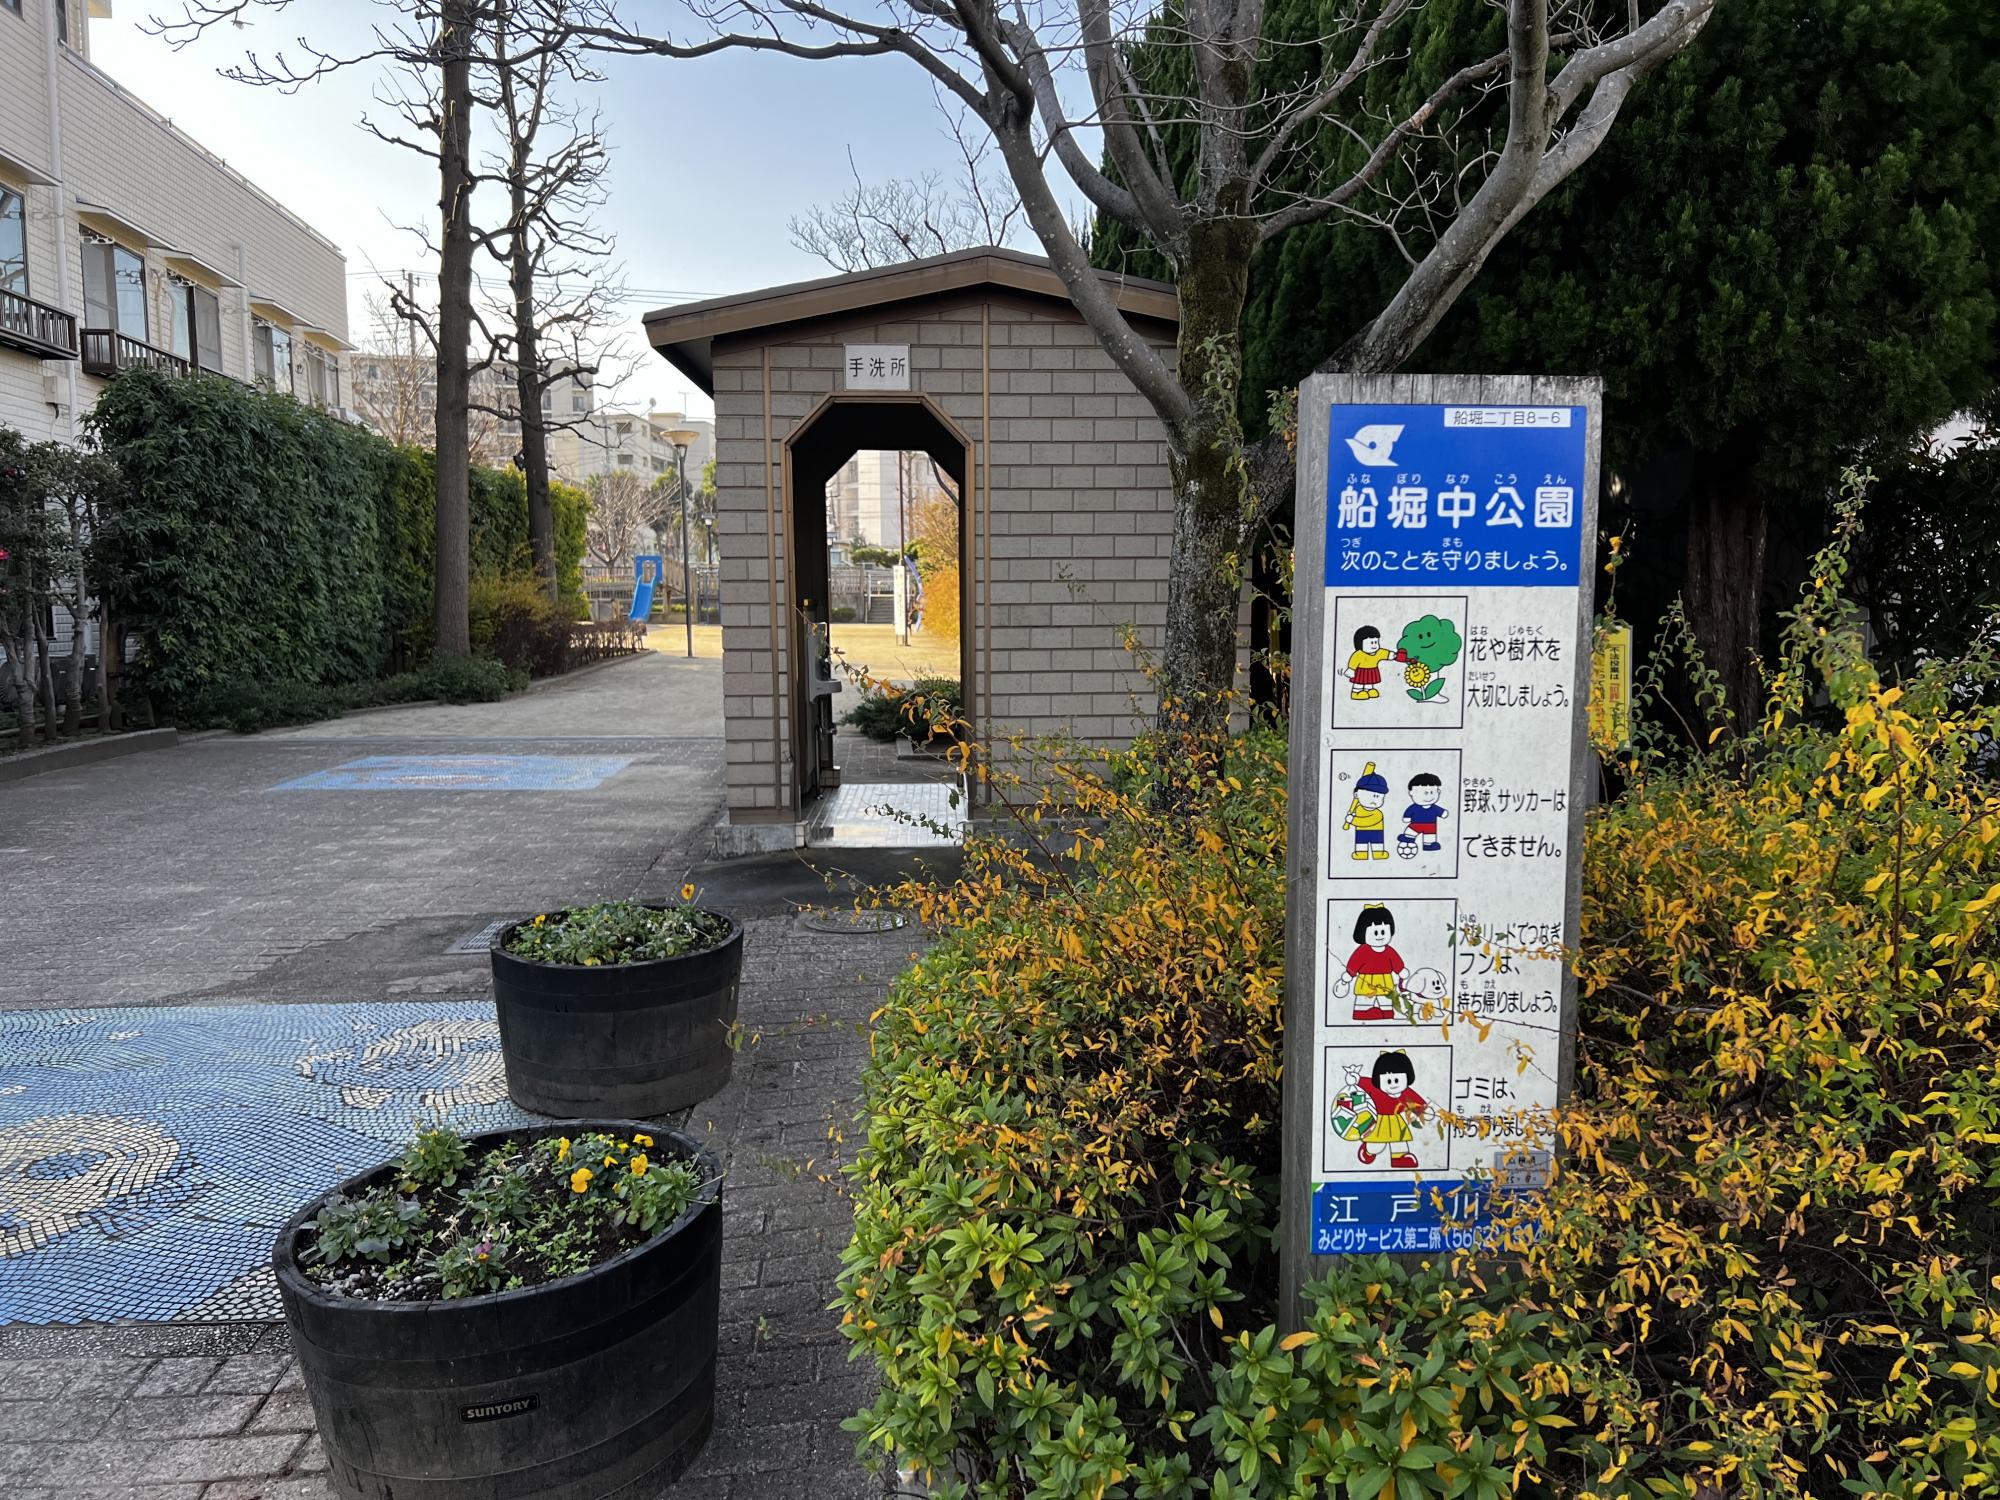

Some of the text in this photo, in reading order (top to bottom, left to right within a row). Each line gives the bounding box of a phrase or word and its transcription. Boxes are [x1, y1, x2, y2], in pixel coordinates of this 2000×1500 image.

[849, 357, 906, 378] 手洗所
[1337, 485, 1573, 529] 船堀中公園
[1340, 549, 1567, 571] 次のことを守りましょう。
[1469, 636, 1561, 662] 花や樹木を
[1467, 684, 1569, 707] 大切にしましょう。
[1463, 788, 1566, 813] 野球、サッカーは
[1463, 833, 1562, 858] できません。
[1457, 991, 1558, 1014] 持ち帰りましょう。
[1455, 1077, 1516, 1100] ゴミは、
[1329, 1192, 1541, 1224] 江戸川
[467, 1399, 530, 1419] SUNTORY
